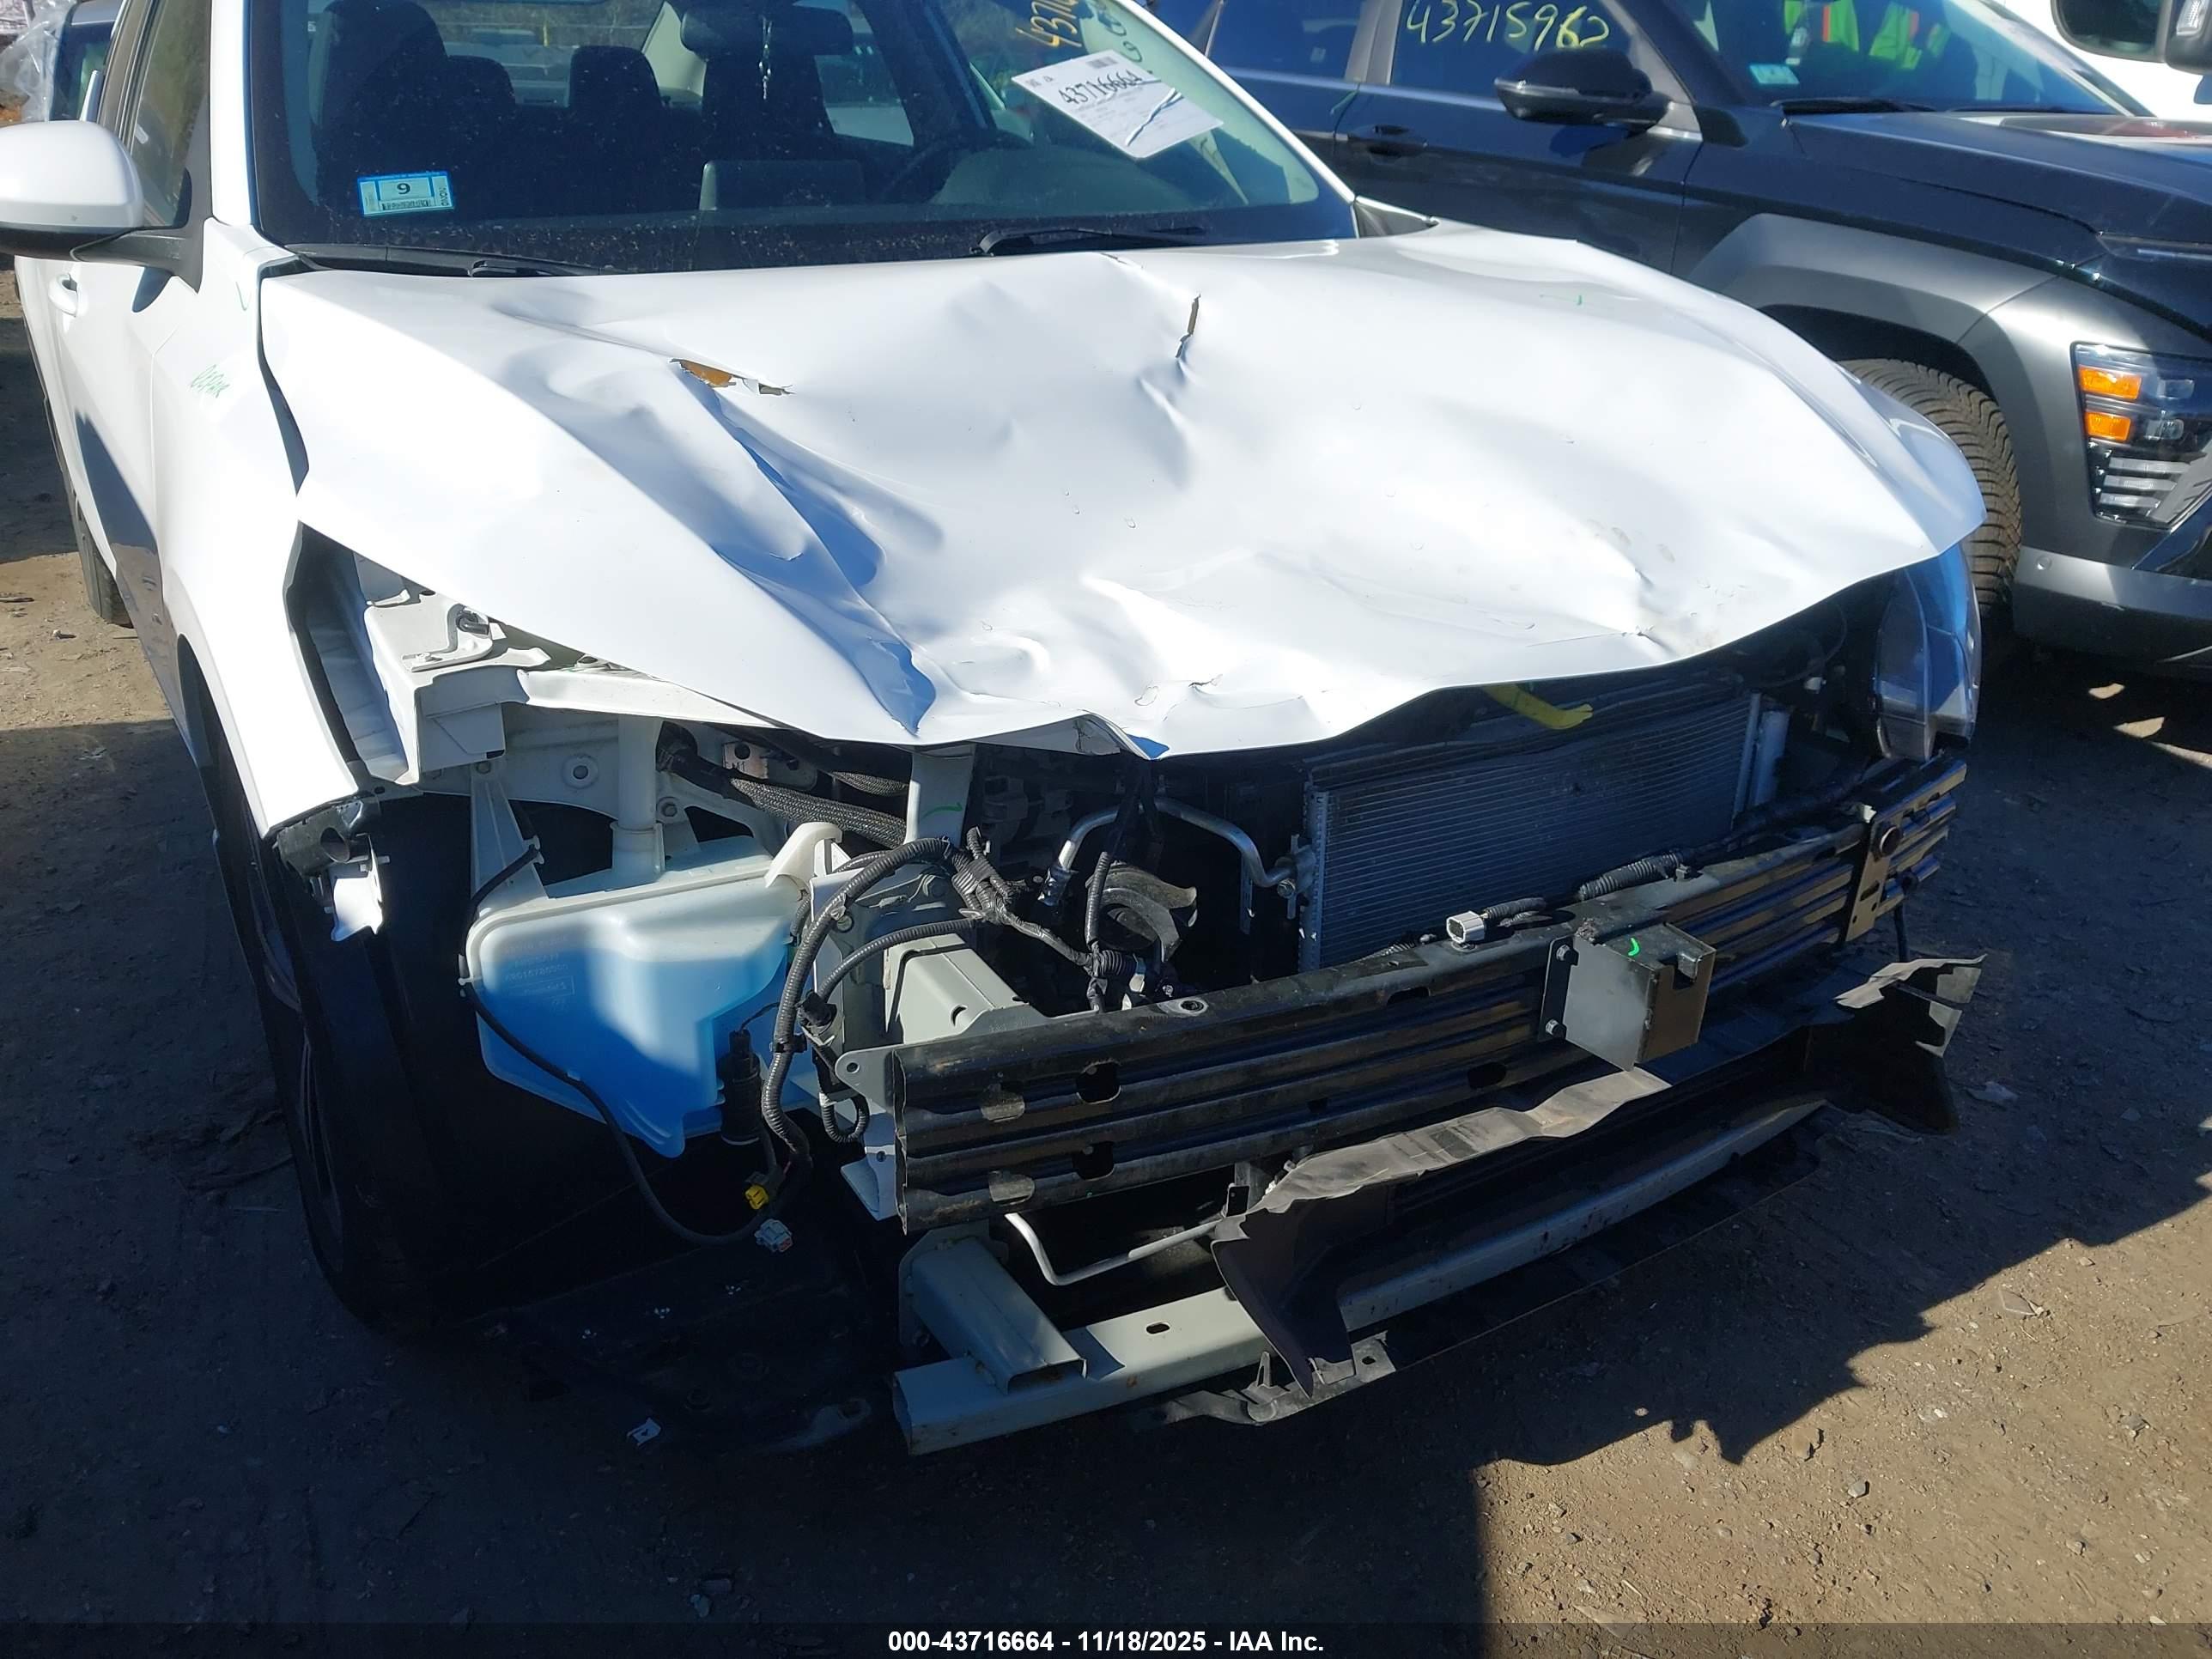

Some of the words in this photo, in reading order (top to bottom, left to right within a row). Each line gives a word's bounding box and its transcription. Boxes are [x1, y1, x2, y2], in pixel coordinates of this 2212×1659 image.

[1406, 0, 1610, 51] 43715962
[1058, 70, 1144, 105] 43716664
[397, 182, 411, 195] 9
